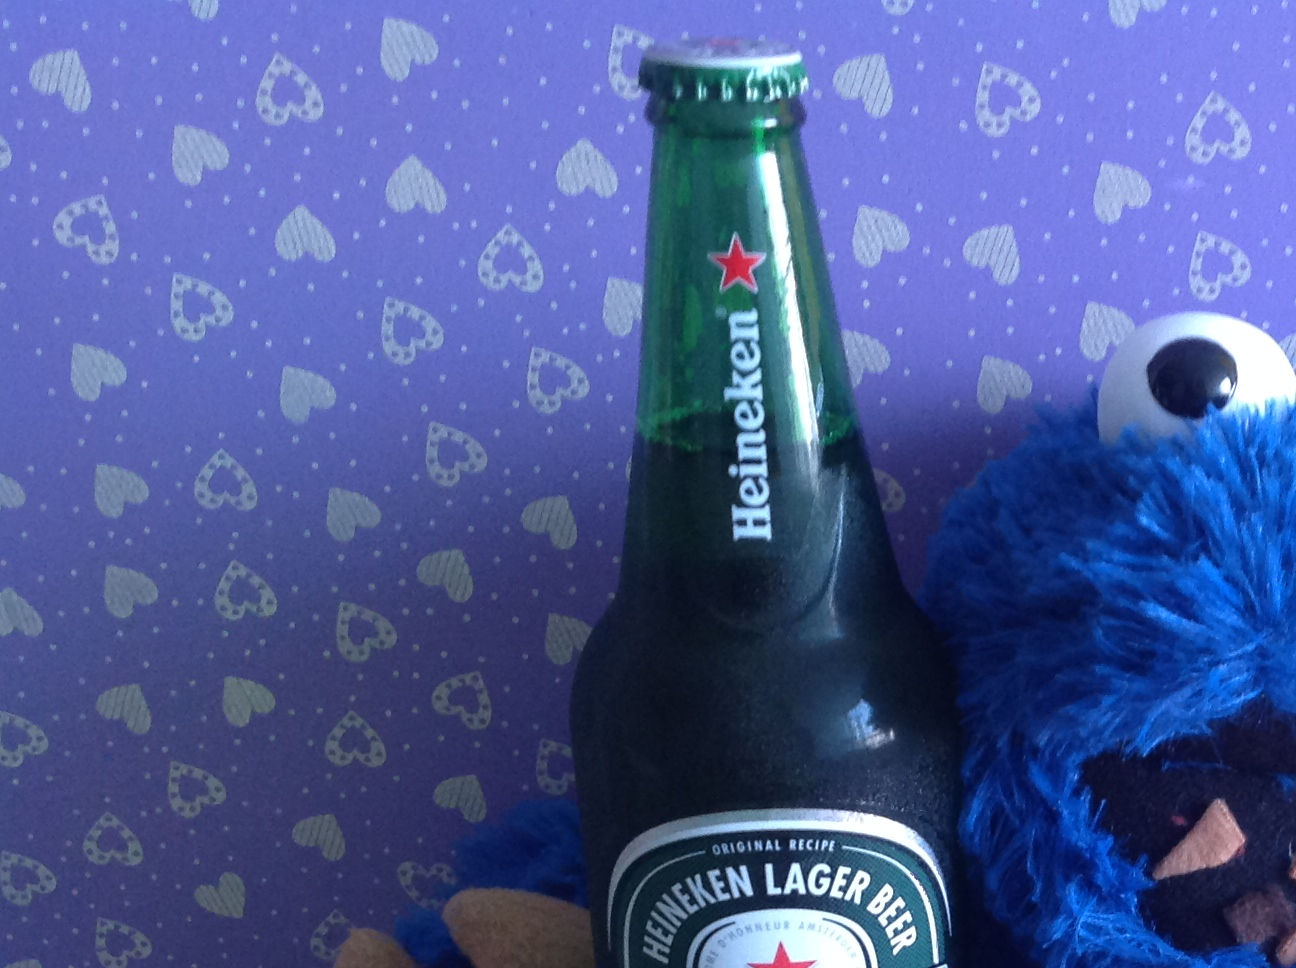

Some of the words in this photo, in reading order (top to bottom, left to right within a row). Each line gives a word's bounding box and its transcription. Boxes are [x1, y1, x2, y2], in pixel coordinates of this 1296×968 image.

[724, 307, 773, 542] Heineken
[712, 839, 781, 856] ORIGINAL
[789, 839, 836, 852] RECIPE
[642, 862, 754, 965] HEINEKEN
[765, 862, 871, 905] LAGER
[866, 883, 917, 955] BEER
